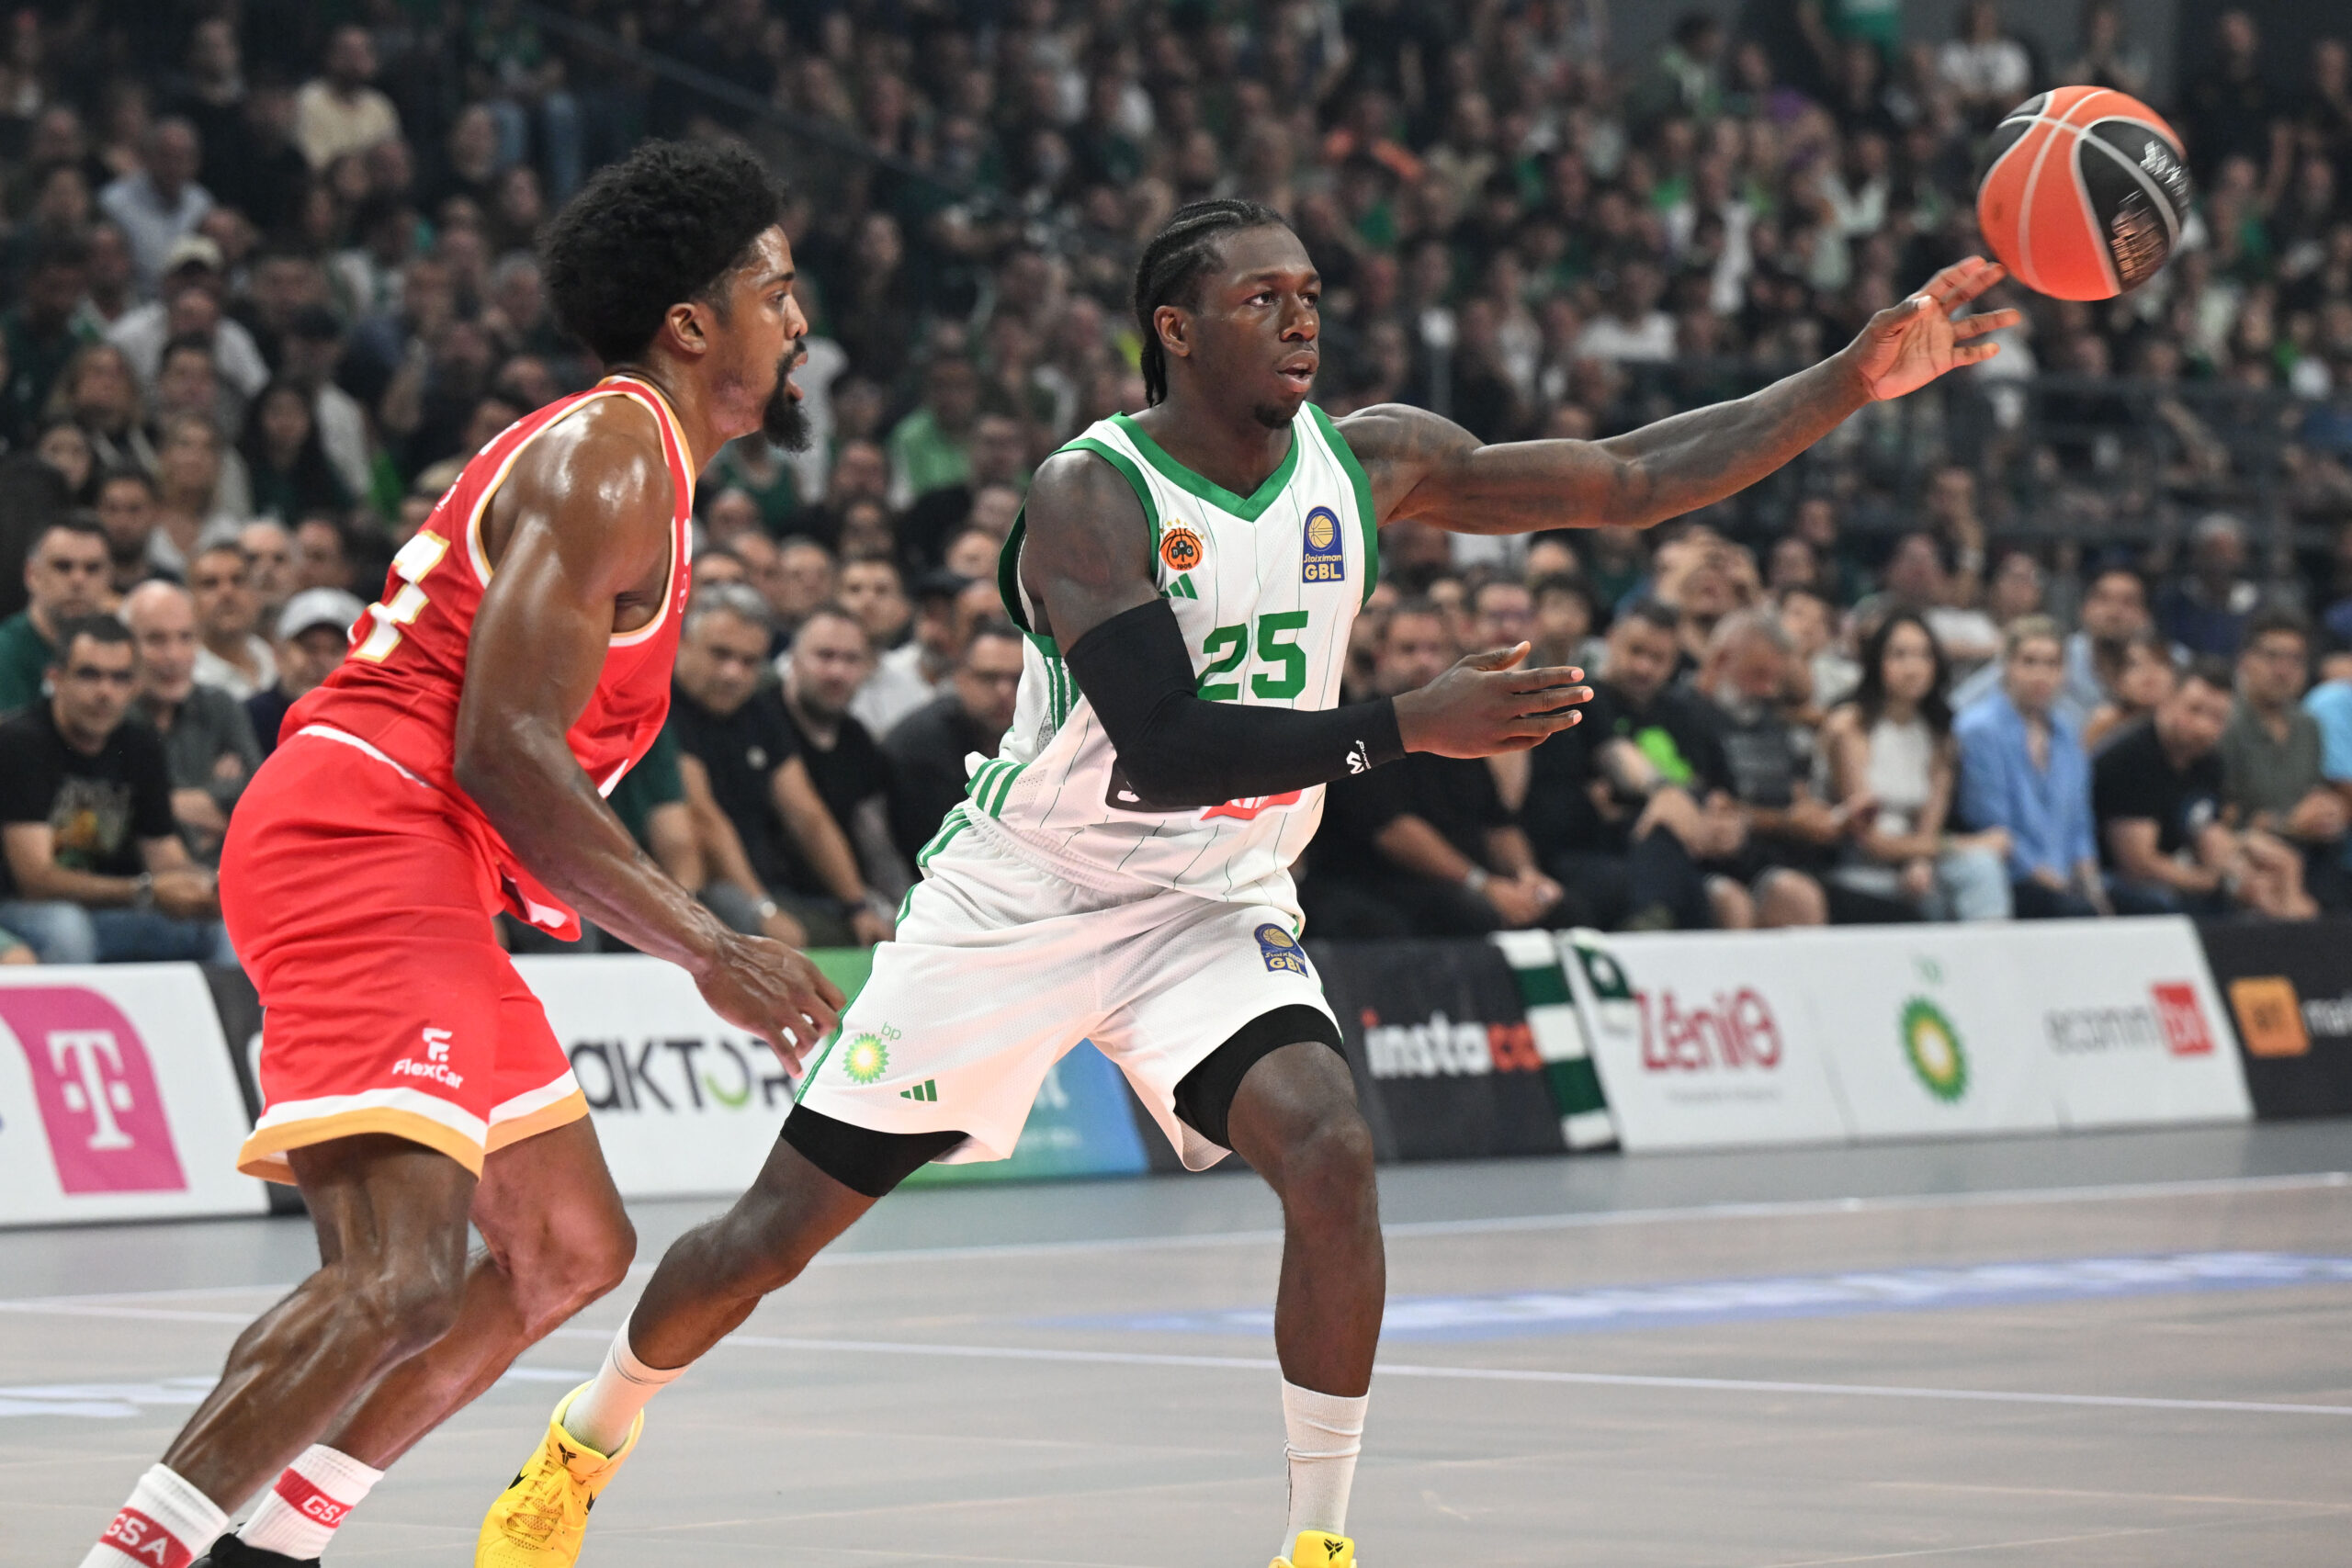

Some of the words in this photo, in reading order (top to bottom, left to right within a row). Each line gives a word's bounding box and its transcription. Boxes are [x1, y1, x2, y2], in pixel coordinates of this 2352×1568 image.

[1303, 554, 1342, 563] Stoiximan
[1305, 563, 1341, 581] GBL
[1195, 610, 1309, 701] 25
[1269, 957, 1307, 977] GBL
[881, 1021, 901, 1042] bp
[391, 1058, 464, 1089] FlexCar
[105, 1514, 168, 1566] GSA
